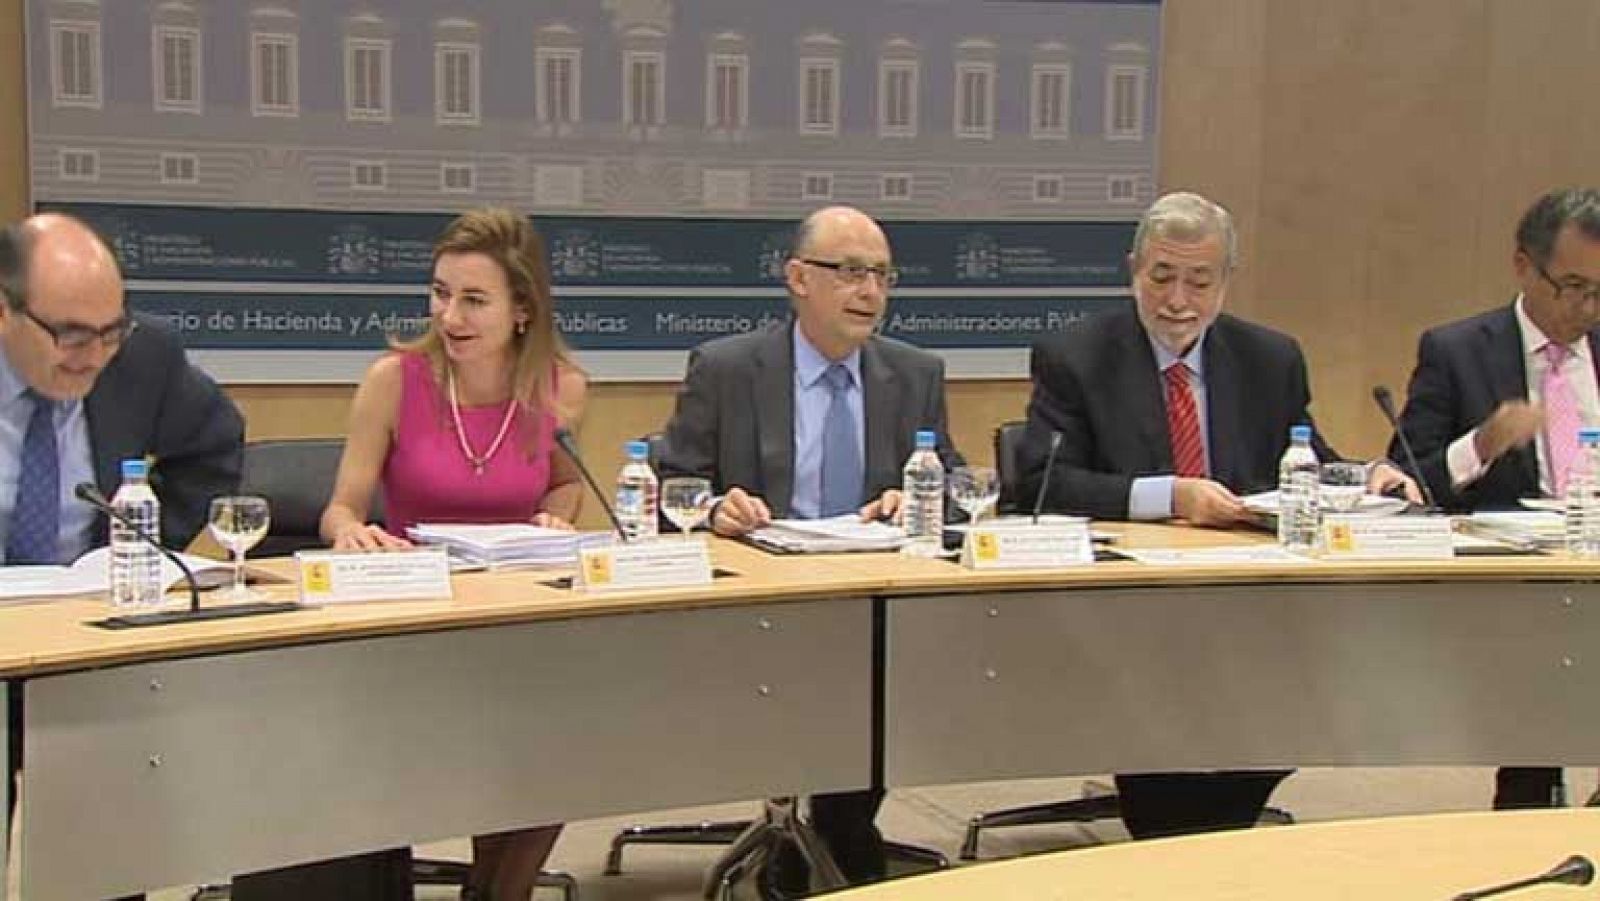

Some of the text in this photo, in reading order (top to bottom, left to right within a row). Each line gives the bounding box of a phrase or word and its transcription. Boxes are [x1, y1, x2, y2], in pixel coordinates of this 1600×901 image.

[207, 310, 234, 330] de
[243, 310, 342, 331] Hacienda
[655, 312, 751, 334] Ministerio
[888, 312, 1042, 332] Administraciones
